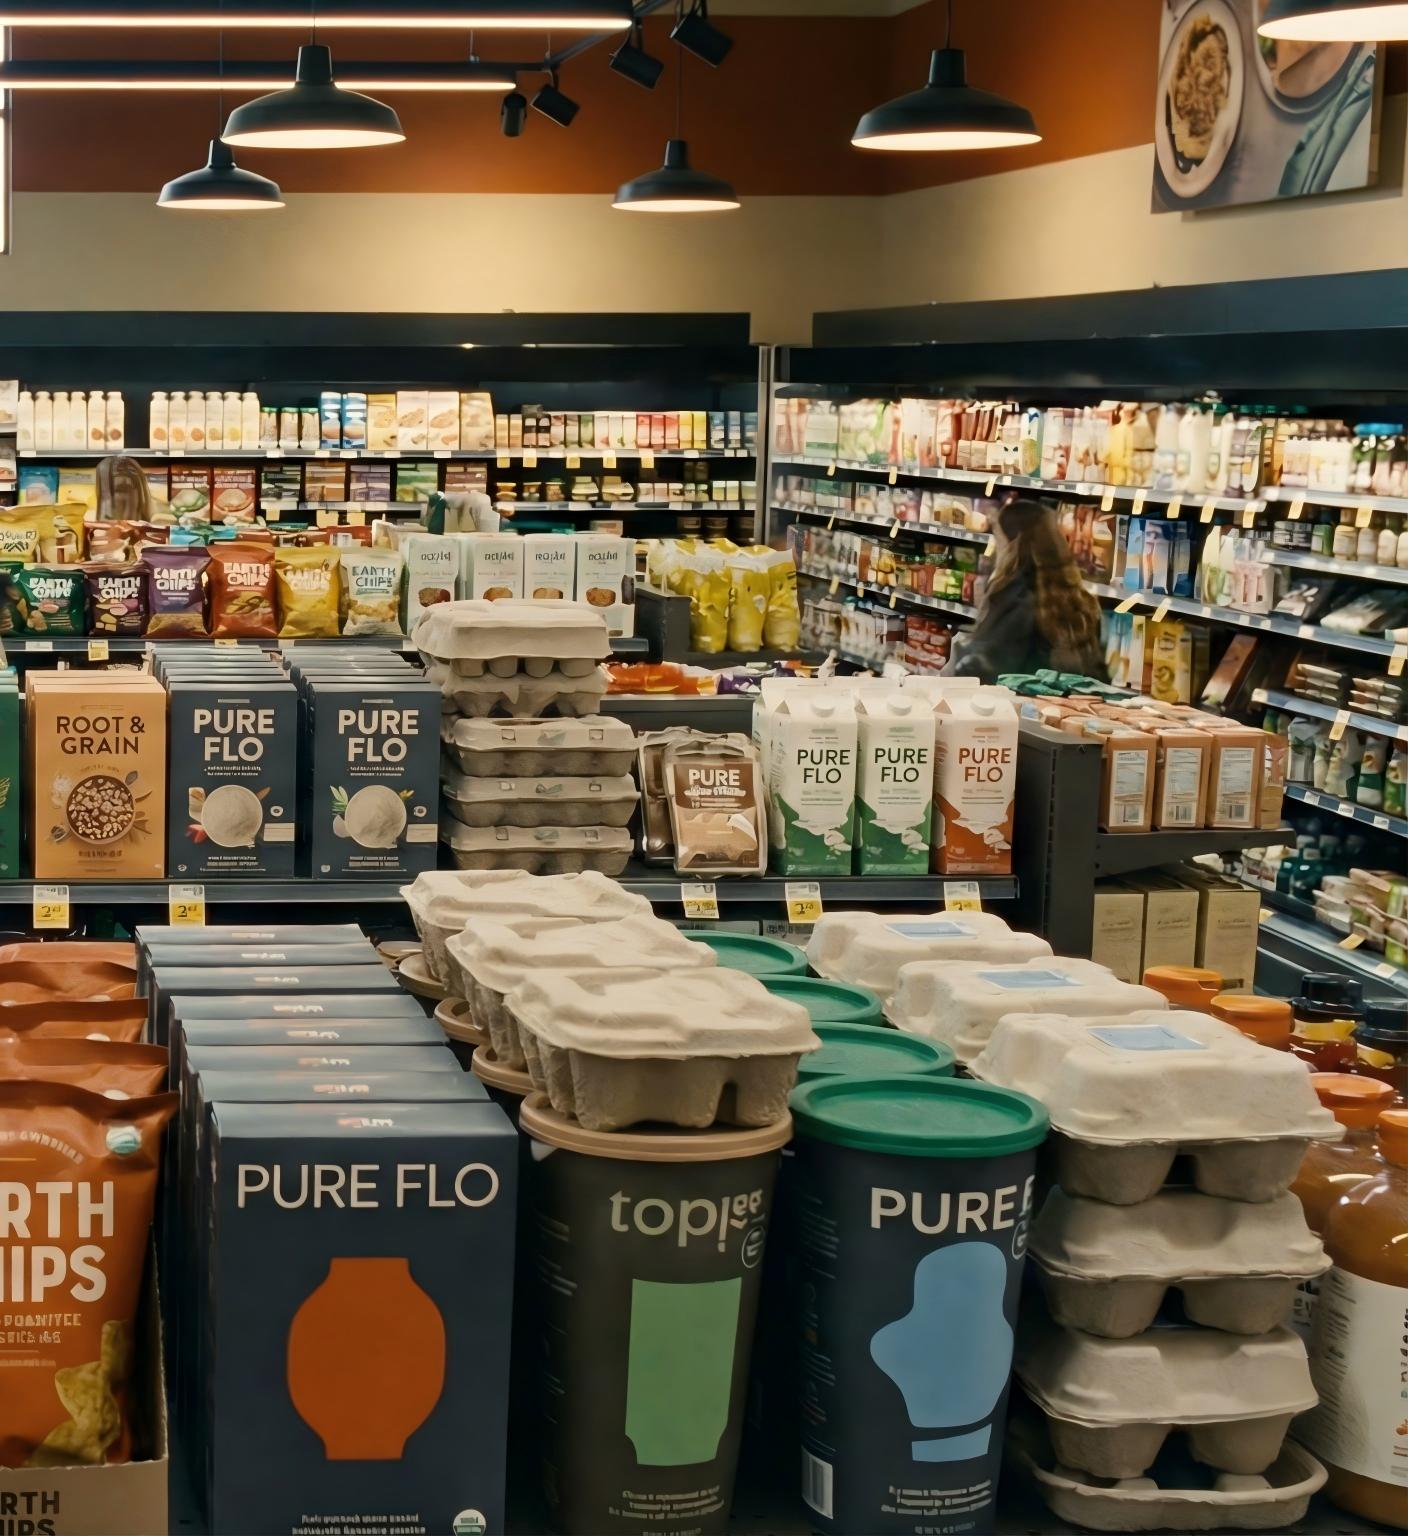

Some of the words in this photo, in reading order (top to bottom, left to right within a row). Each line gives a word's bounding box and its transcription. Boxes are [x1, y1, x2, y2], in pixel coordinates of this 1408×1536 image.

[56, 716, 127, 734] ROOT
[130, 716, 146, 734] &
[194, 709, 276, 735] PURE
[338, 709, 420, 735] PURE
[60, 736, 140, 755] GRAIN
[204, 736, 264, 762] FLO
[347, 737, 407, 762] FLO
[797, 749, 851, 766] PURE
[874, 747, 928, 765] PURE
[958, 747, 1012, 765] PURE
[688, 768, 741, 786] PURE
[803, 767, 842, 784] FLO
[880, 766, 920, 783] FLO
[964, 765, 1004, 783] FLO
[237, 1164, 380, 1209] PURE
[396, 1163, 500, 1208] FLO
[870, 1184, 1018, 1235] PURE
